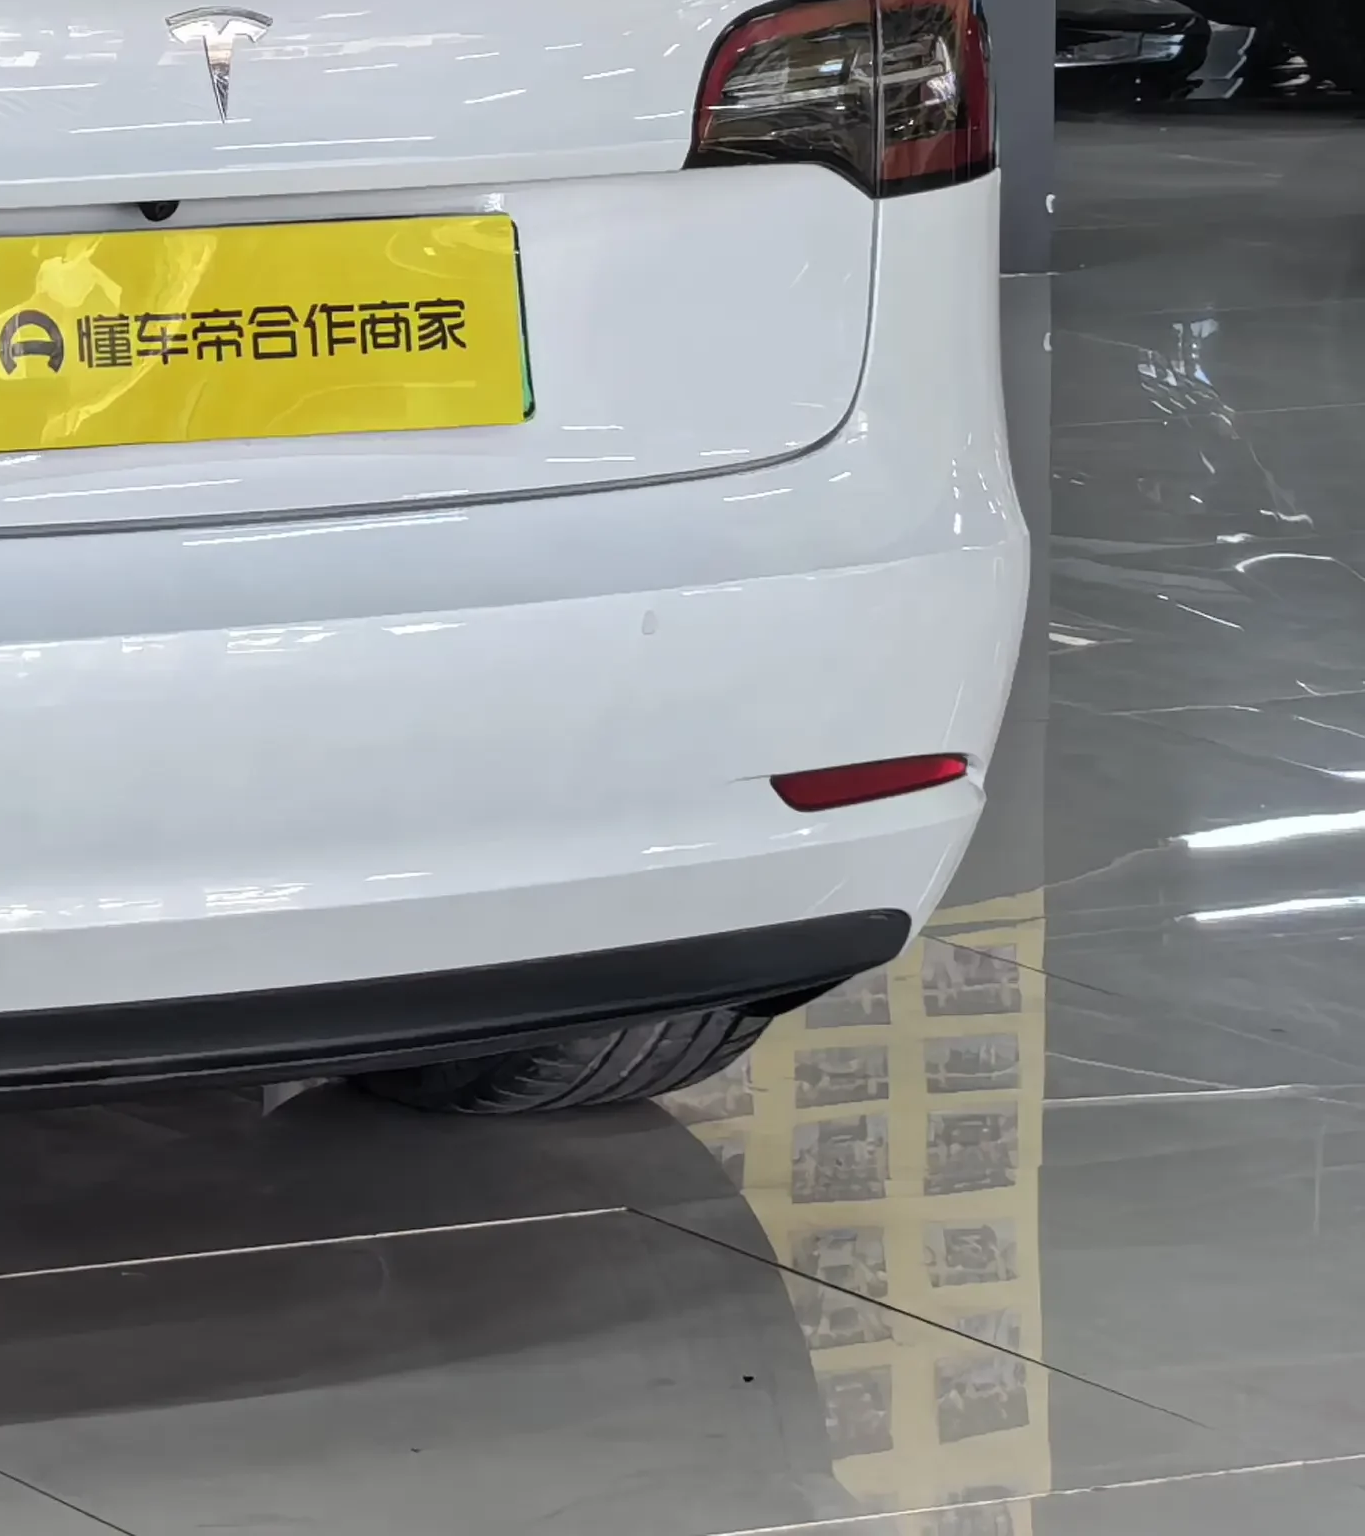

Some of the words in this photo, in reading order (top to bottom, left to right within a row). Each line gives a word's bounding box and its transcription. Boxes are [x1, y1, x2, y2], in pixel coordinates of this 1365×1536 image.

[76, 297, 467, 368] 懂车帝合作商家
